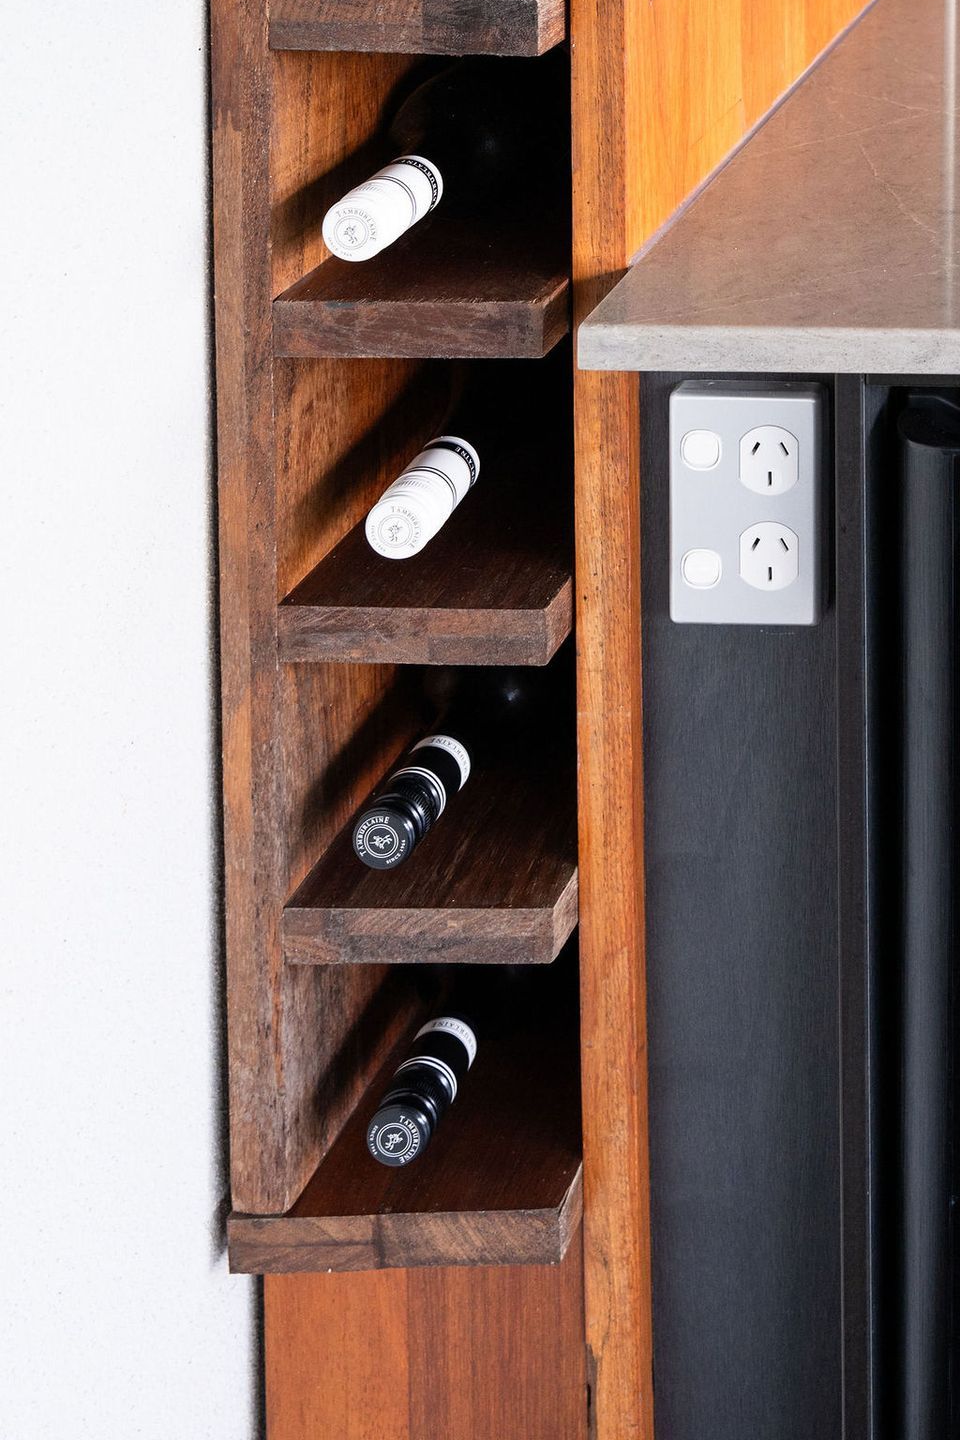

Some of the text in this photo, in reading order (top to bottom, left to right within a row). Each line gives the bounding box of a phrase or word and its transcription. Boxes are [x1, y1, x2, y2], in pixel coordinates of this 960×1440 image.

[335, 208, 377, 241] TAMBURLAINE
[356, 816, 390, 857] TAMBURLAINE
[385, 852, 402, 865] SINCE
[399, 1115, 420, 1164] TAMBURLAINE
